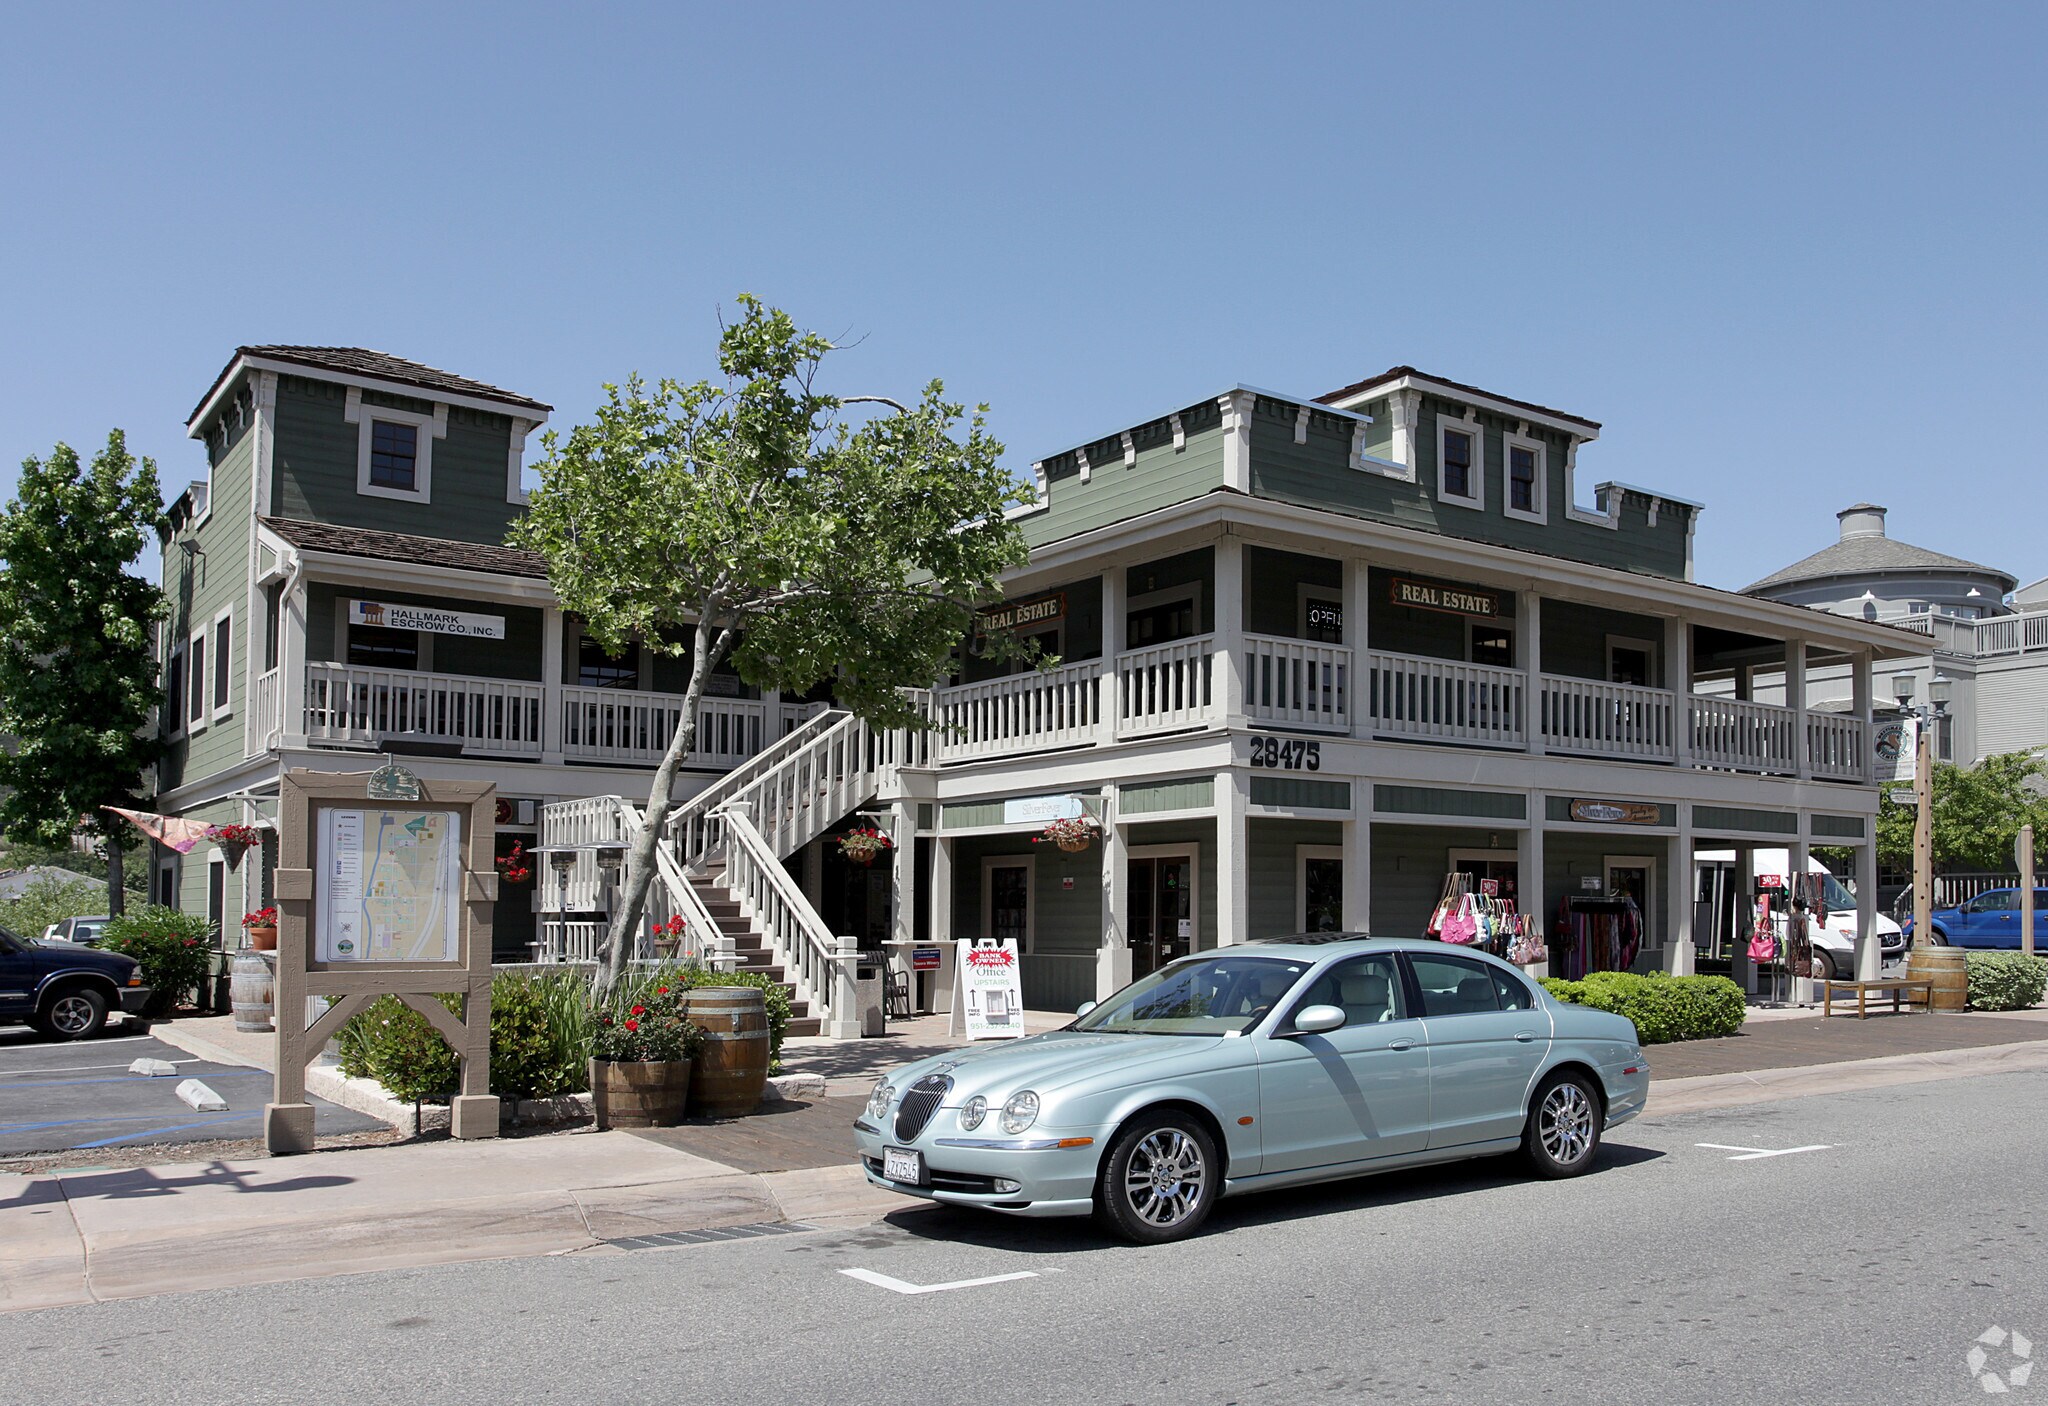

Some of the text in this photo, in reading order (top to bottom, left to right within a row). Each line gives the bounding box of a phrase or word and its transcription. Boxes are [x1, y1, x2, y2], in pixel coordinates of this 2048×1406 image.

[1402, 584, 1490, 613] REAL ESTATE
[391, 609, 459, 624] HALLMARK
[983, 599, 1057, 630] REAL ESTATE
[391, 618, 496, 636] ESCROW CO., INC.
[1250, 736, 1320, 771] 28475
[976, 967, 1006, 976] Office
